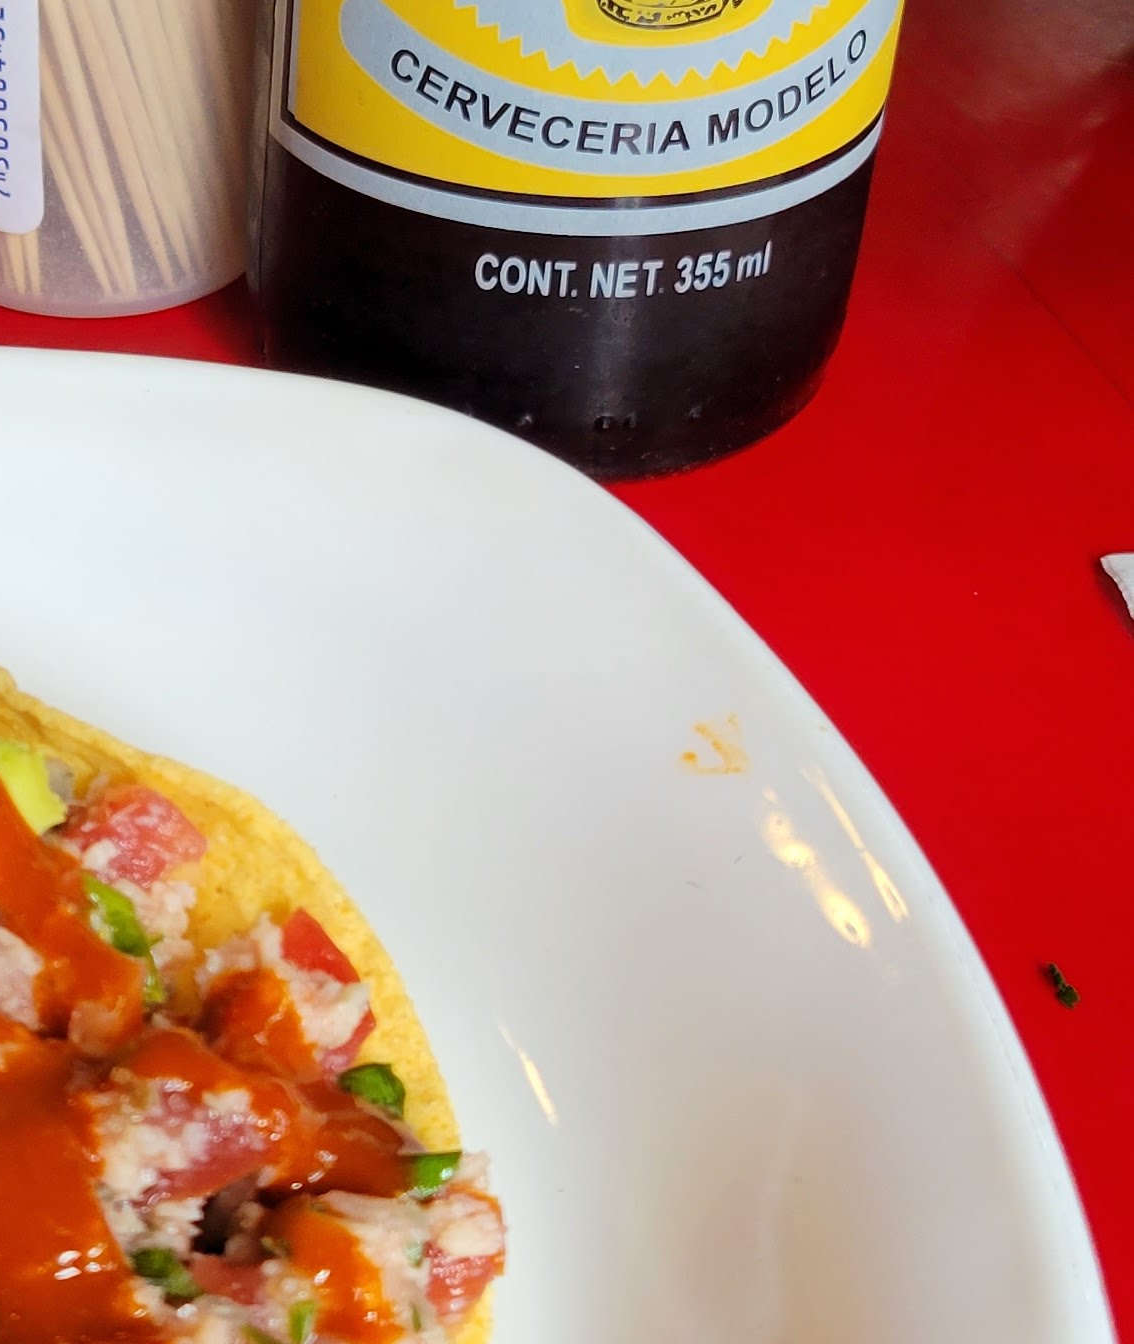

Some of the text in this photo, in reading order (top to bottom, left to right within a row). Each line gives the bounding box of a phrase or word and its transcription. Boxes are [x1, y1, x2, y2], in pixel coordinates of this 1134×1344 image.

[390, 29, 867, 156] CERVECERIA MODELO
[474, 239, 773, 299] CONT. NET. 355 ml
